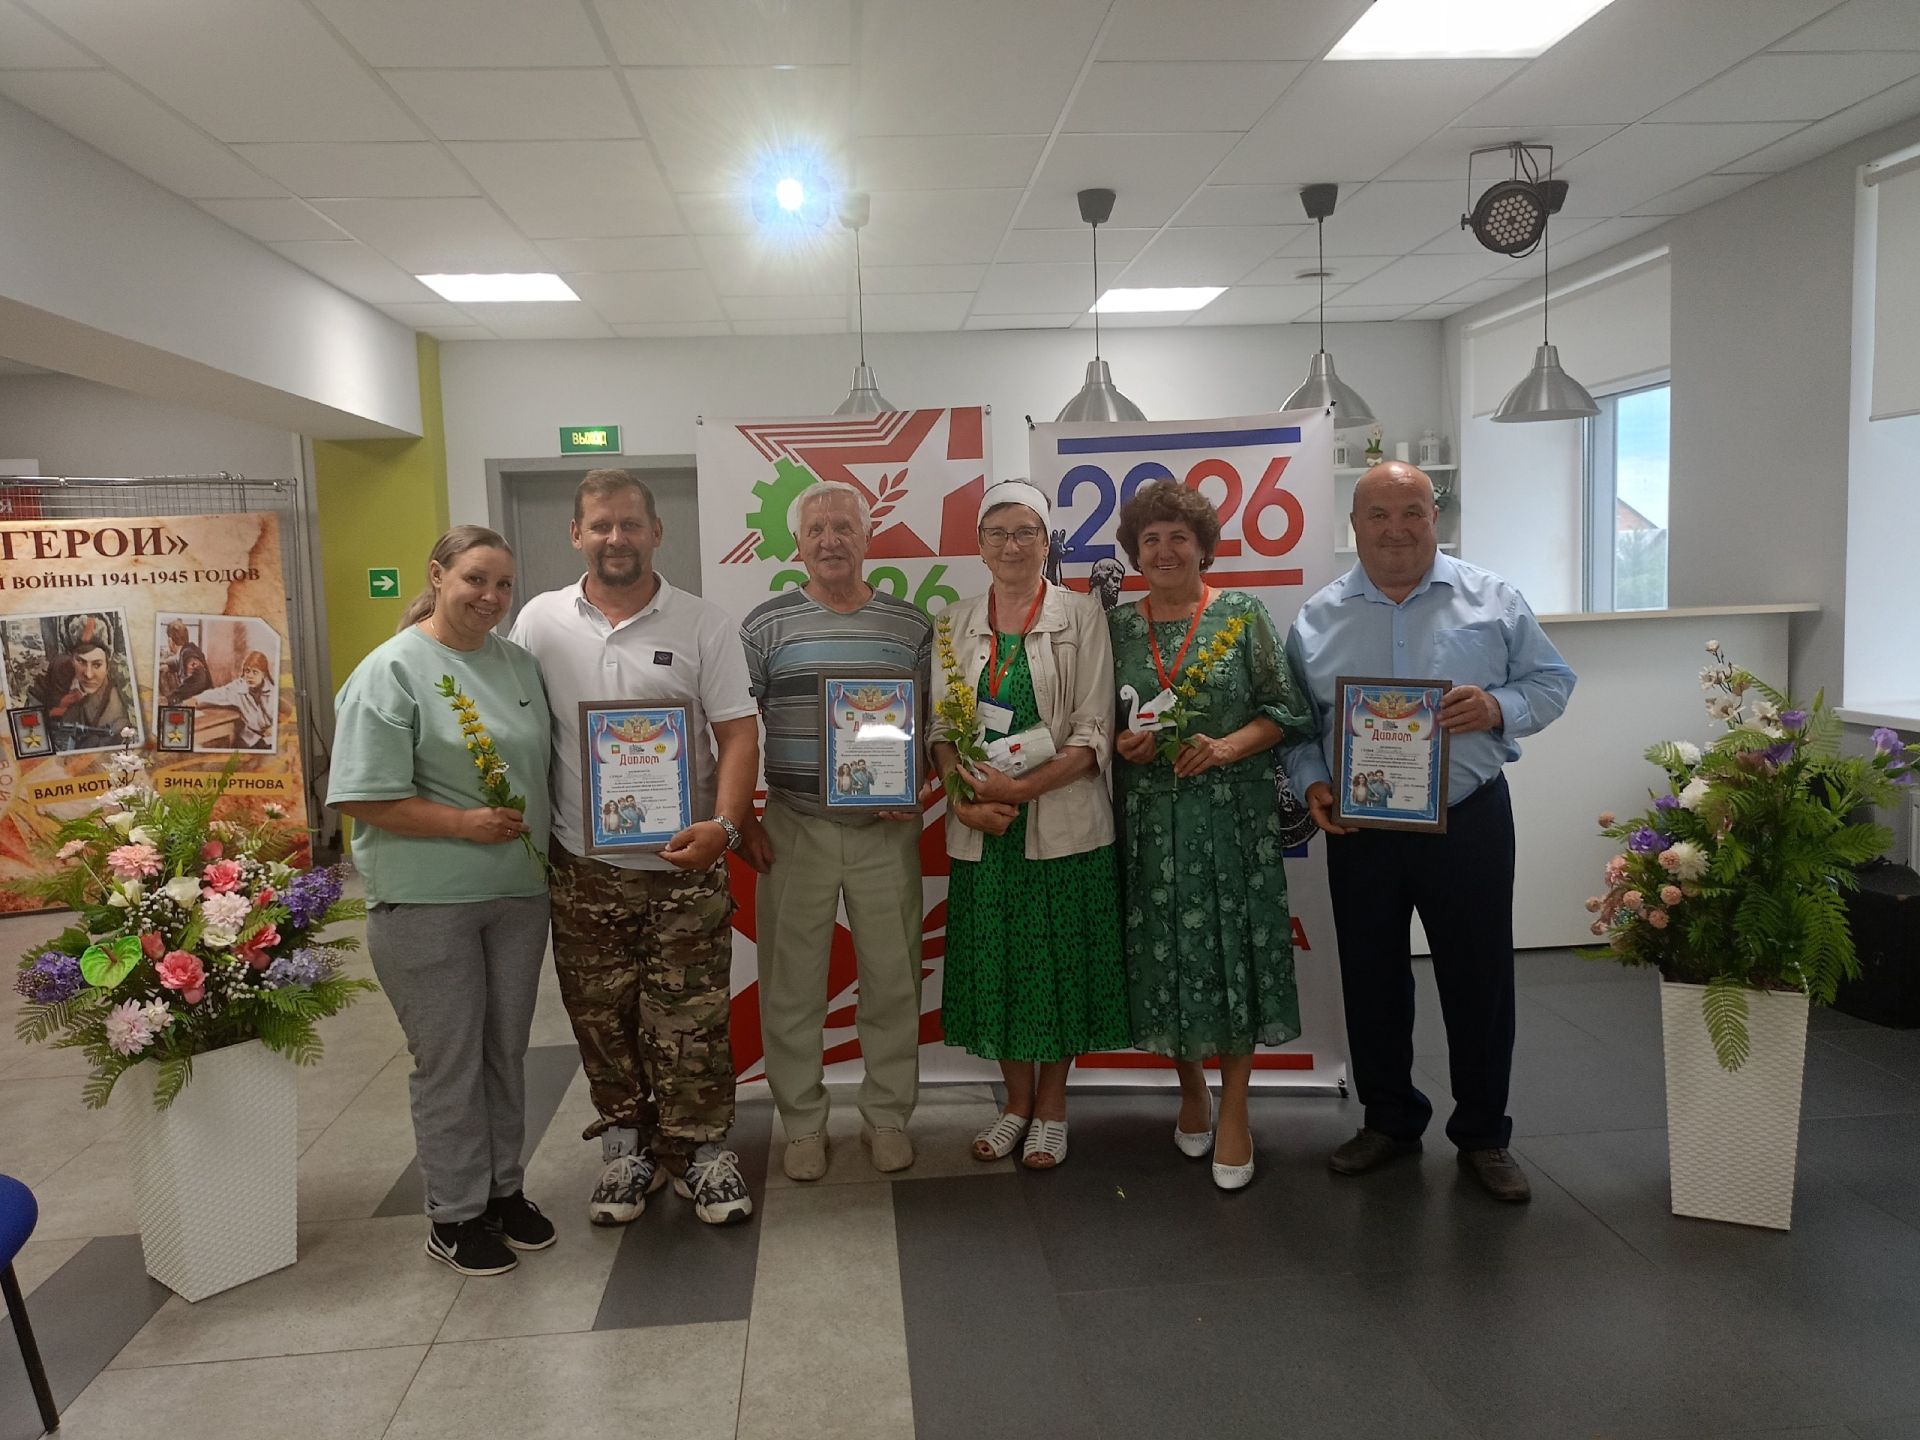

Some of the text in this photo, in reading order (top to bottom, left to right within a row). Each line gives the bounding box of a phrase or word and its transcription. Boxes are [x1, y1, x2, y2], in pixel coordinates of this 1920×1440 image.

[12, 571, 95, 589] ВОЙНЫ
[101, 570, 188, 586] 1941-1945
[193, 568, 260, 583] ГОДОВ
[164, 777, 203, 788] ЗИНА
[34, 784, 74, 799] ВАЛЯ
